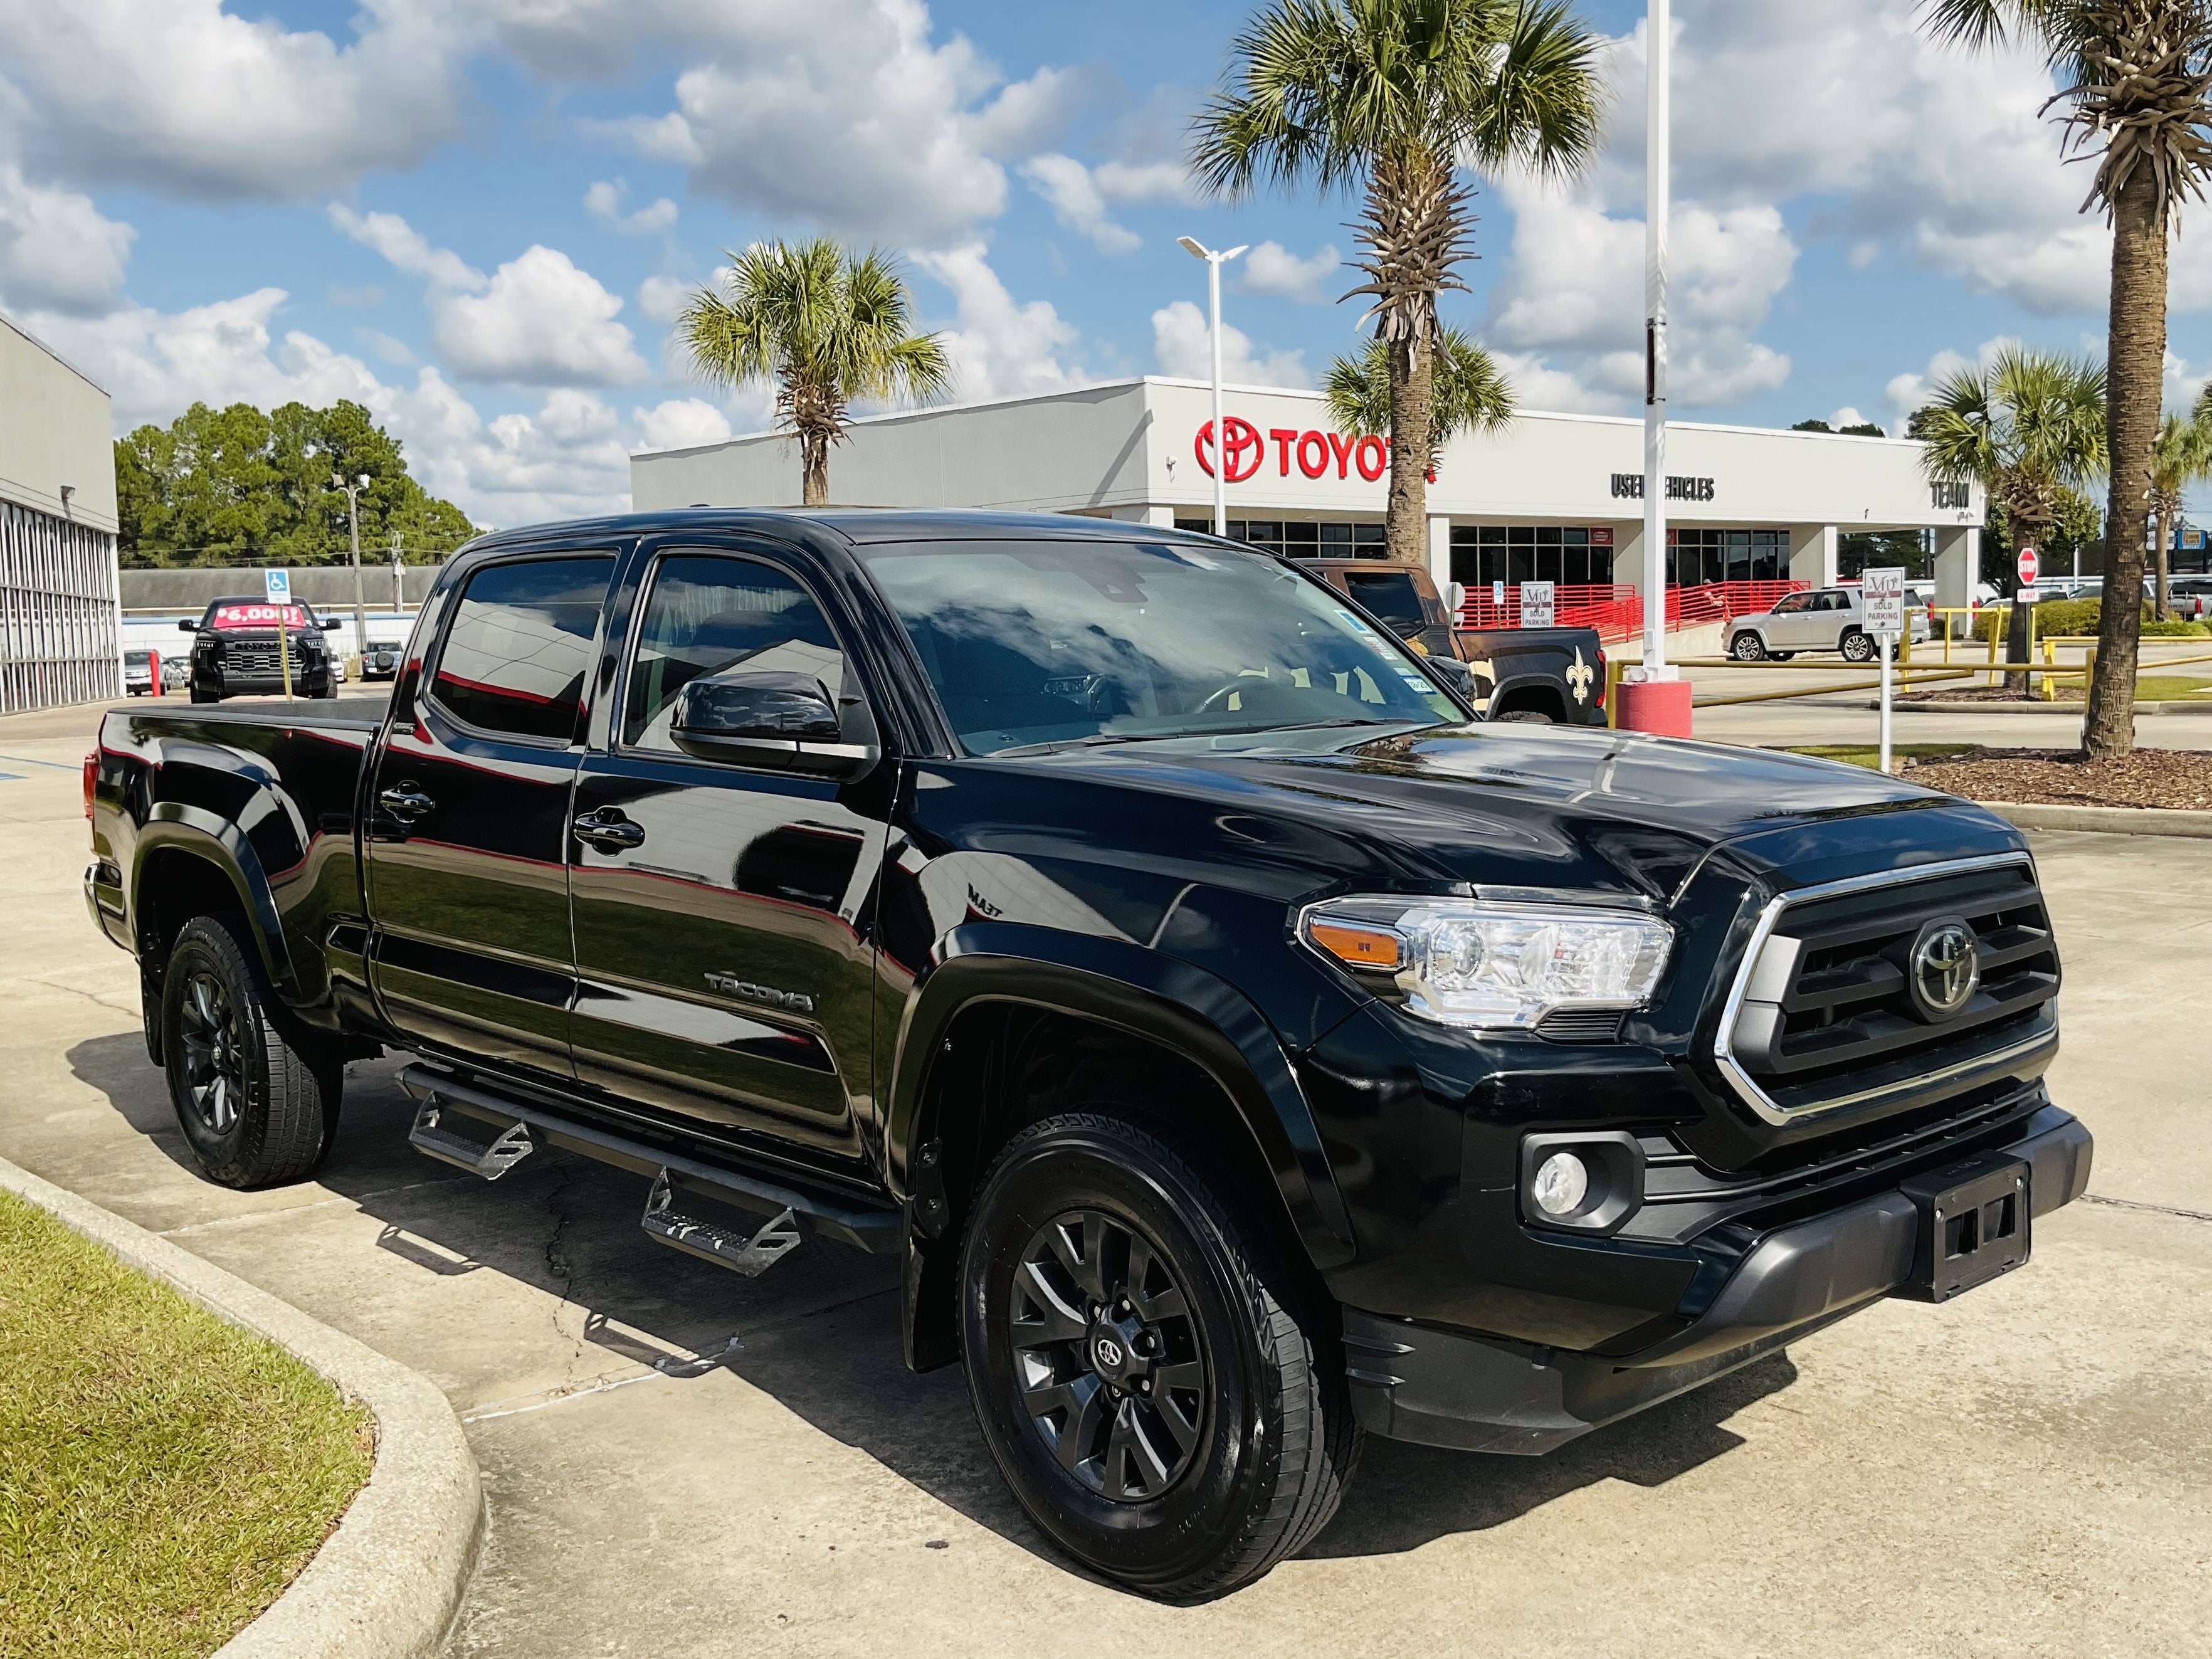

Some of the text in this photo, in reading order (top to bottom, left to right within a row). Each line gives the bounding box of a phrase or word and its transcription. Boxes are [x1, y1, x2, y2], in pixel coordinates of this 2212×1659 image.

[1270, 428, 1436, 485] TOYO
[1665, 476, 1715, 502] EHICLES
[1929, 481, 1969, 509] TEAM
[2020, 560, 2036, 572] STOP
[1874, 602, 1892, 610] SOLD
[703, 972, 813, 1011] TACOMA
